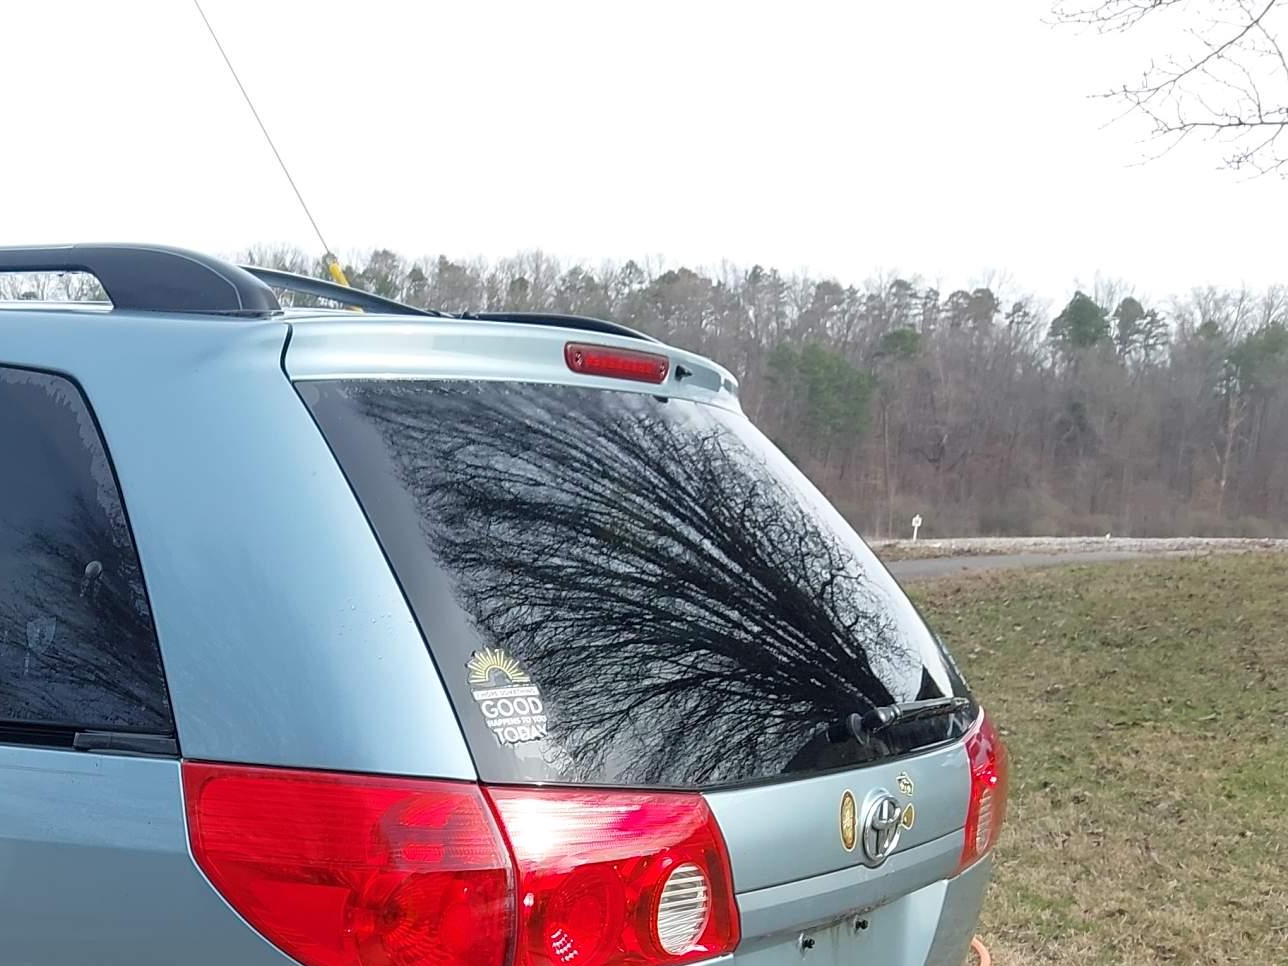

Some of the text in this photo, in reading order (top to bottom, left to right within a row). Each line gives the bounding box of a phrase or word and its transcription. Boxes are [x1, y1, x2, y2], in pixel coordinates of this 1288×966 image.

[481, 697, 543, 718] GOOD
[486, 717, 522, 727] HAPPENS
[522, 716, 532, 725] TO
[494, 724, 548, 744] TODAY
